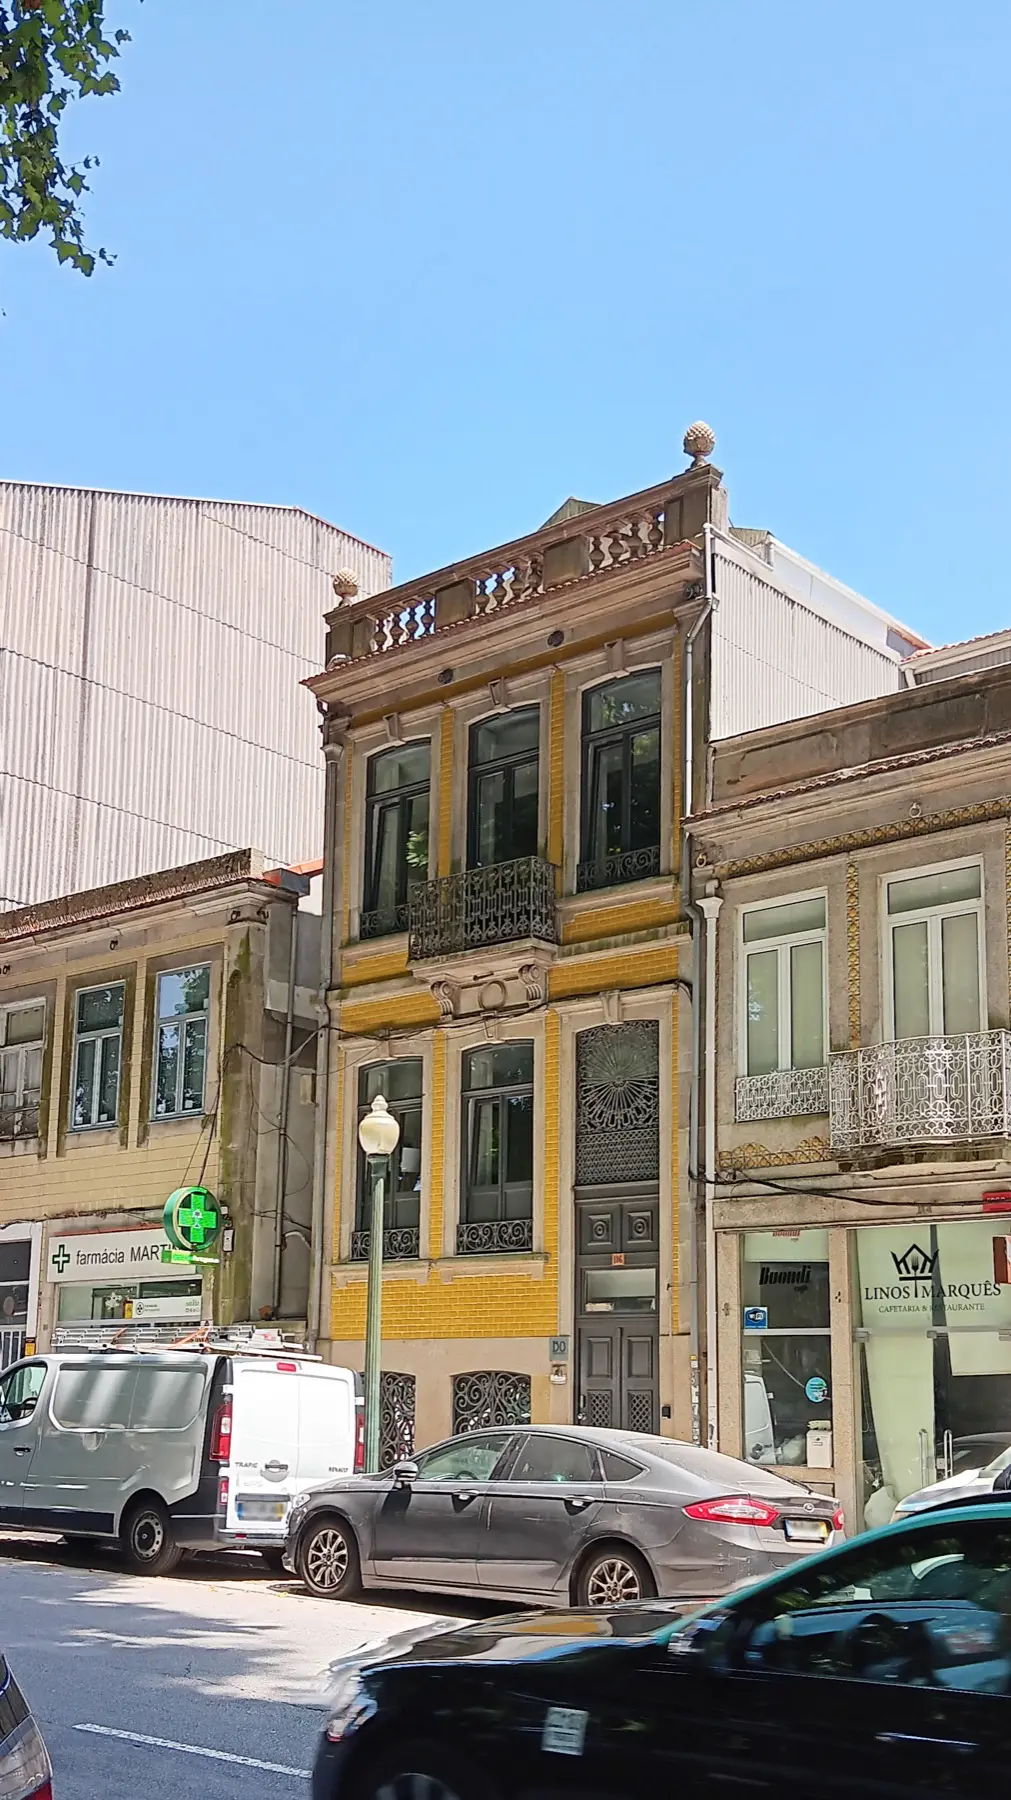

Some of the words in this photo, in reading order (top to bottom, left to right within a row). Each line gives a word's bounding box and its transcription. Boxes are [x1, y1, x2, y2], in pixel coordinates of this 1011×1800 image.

[76, 1249, 125, 1265] farmácia
[865, 1286, 911, 1300] LINOS
[921, 1280, 1001, 1299] MARQUÊS
[879, 1305, 920, 1313] CAFETARIA
[929, 1303, 985, 1312] RESTAURANTE
